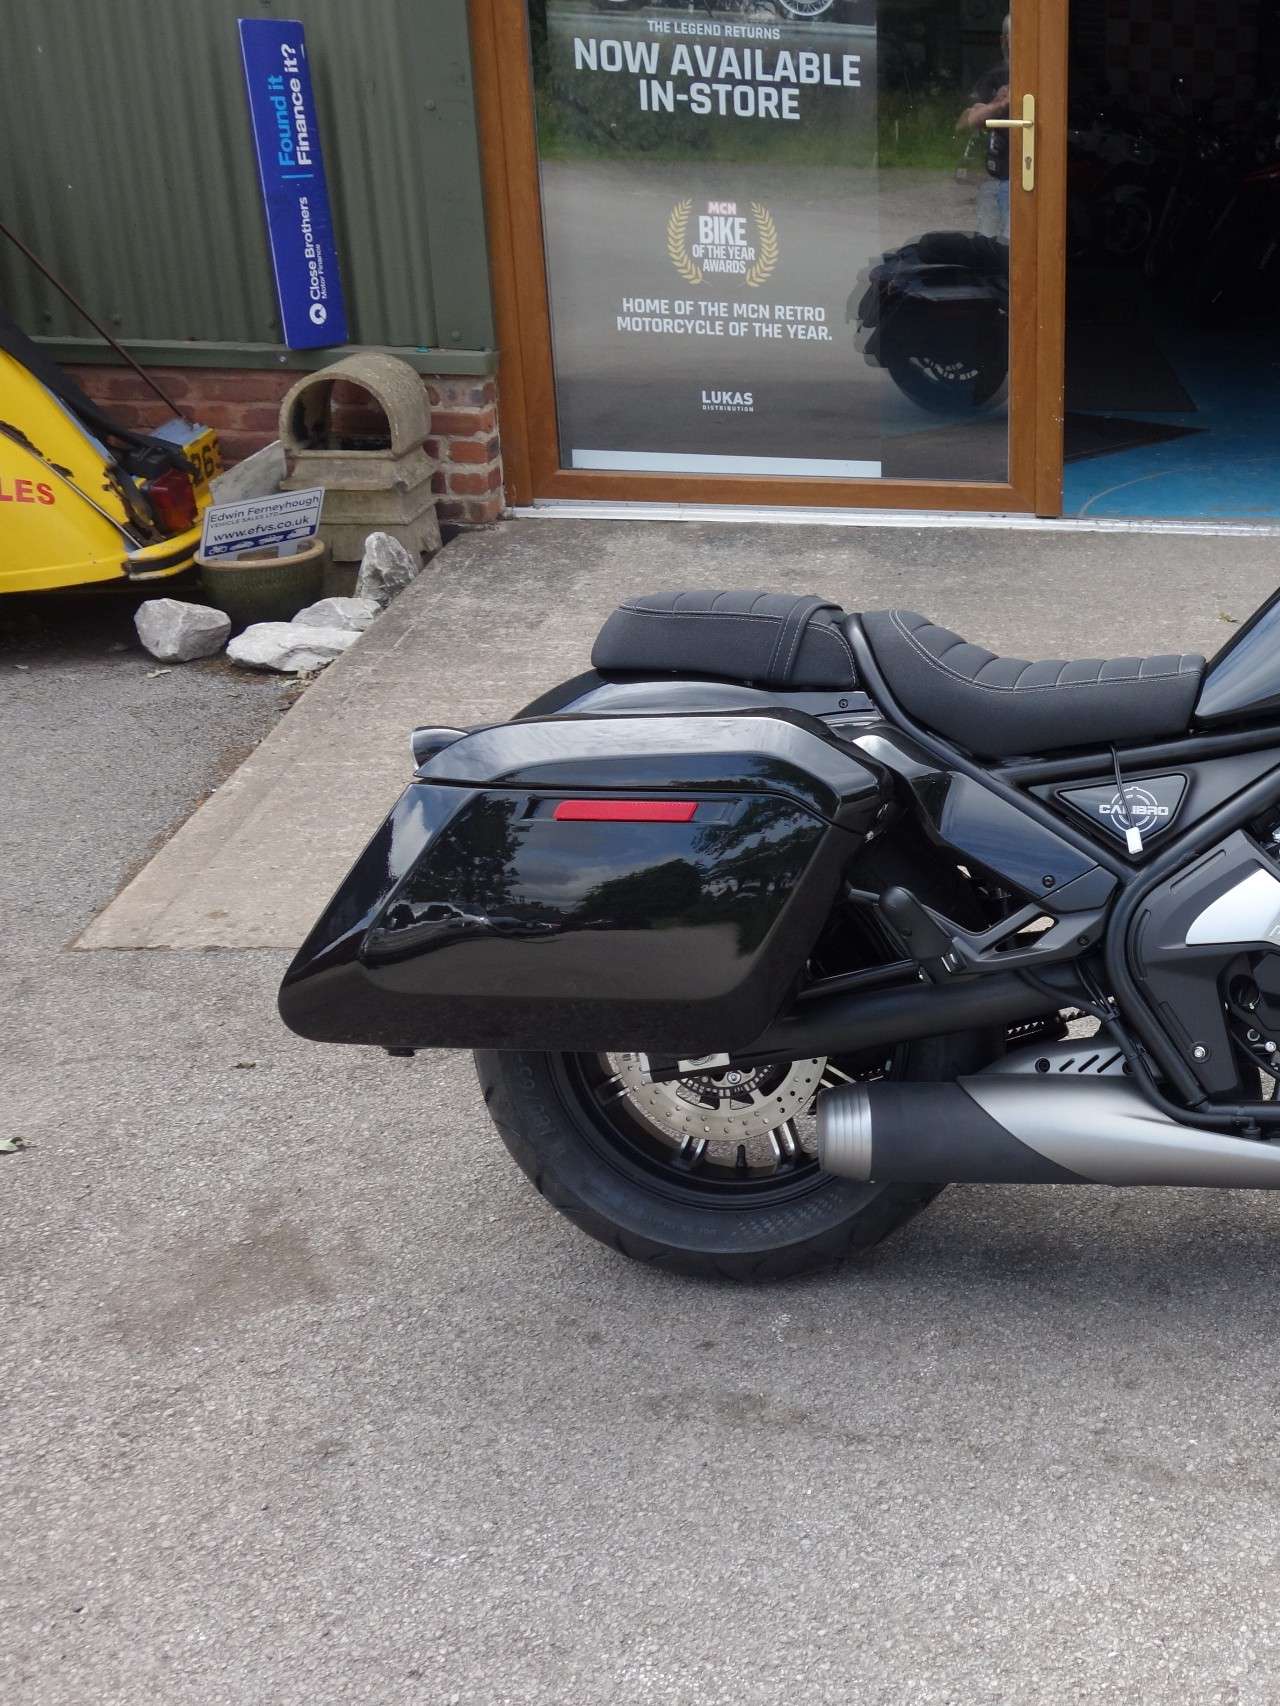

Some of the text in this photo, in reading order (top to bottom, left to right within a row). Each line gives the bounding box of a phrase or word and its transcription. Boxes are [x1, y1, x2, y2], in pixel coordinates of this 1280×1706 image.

[647, 20, 780, 40] THE LEGEND RETURNS
[574, 37, 861, 87] NOW AVAILABLE
[281, 43, 312, 165] Finance it?
[639, 79, 800, 120] IN-STORE
[268, 75, 295, 165] Found it
[708, 202, 736, 215] MCN
[699, 216, 747, 246] BIKE
[299, 196, 320, 300] Close Brothers
[692, 245, 755, 261] OF THE YEAR
[702, 259, 746, 274] AWARDS
[622, 298, 825, 322] HOME OF THE MCN RETRO
[617, 316, 833, 341] MOTORCYCLE OF THE YEAR.
[702, 390, 753, 405] LUKAS
[210, 495, 319, 523] Edwin Ferneyhough
[213, 515, 310, 542] www.efvs.co.uk
